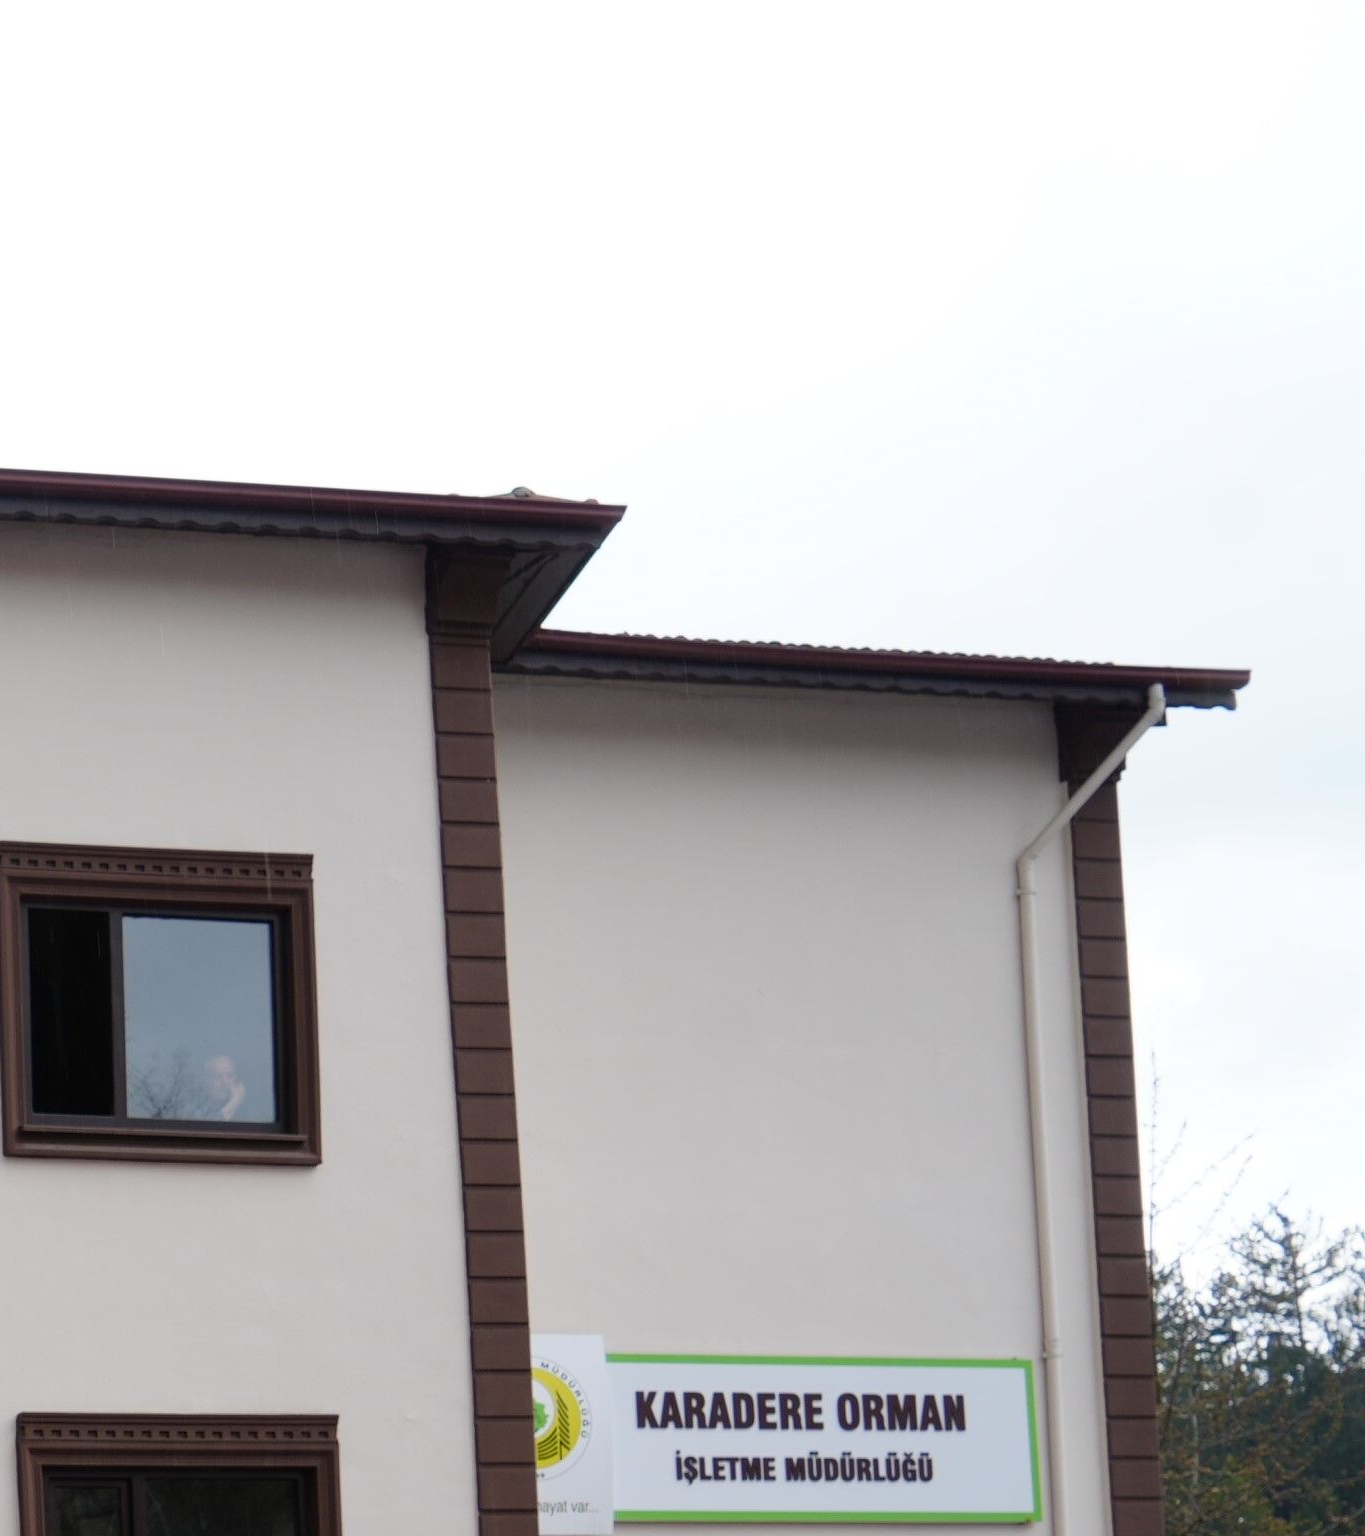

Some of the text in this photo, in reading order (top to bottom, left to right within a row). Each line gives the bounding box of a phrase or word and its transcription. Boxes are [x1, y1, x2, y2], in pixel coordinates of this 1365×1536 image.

[635, 1390, 967, 1432] KARADERE ORMAN
[675, 1449, 934, 1486] İŞLETME MÜDÜRLÜĞÜ
[537, 1500, 568, 1517] ayat
